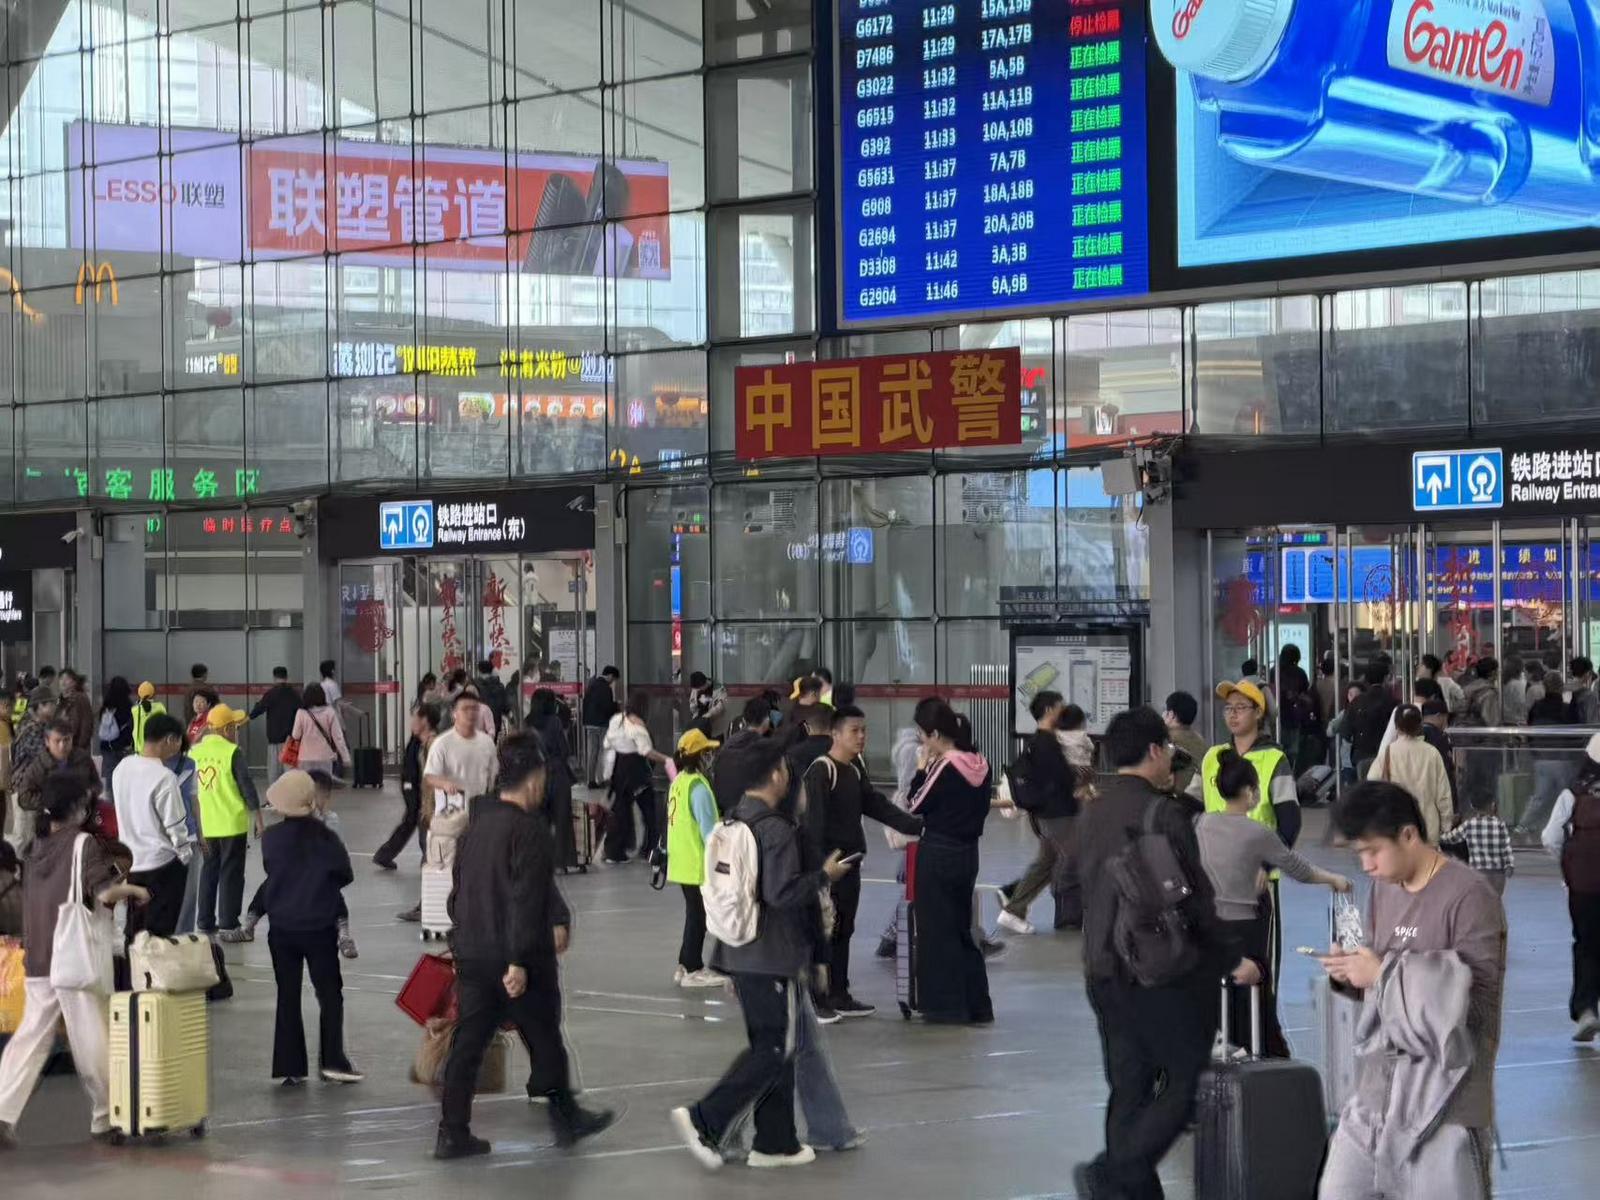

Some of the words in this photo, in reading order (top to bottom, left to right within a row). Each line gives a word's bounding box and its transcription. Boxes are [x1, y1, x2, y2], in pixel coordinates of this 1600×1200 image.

[856, 15, 892, 37] G6172
[924, 5, 954, 27] 11:29
[924, 36, 954, 59] 11:29
[857, 76, 893, 97] G3022
[924, 67, 955, 88] 11:32
[1070, 40, 1119, 68] 正在检票
[925, 98, 955, 118] 11:32
[1070, 73, 1120, 99] 正在检票
[925, 128, 955, 149] 11:33
[1071, 106, 1120, 131] 正在检票
[925, 159, 956, 179] 11:37
[1071, 138, 1121, 162] 正在检票
[181, 182, 225, 208] 联塑
[268, 167, 506, 248] 联塑管道
[862, 197, 891, 216] G908
[925, 189, 956, 209] 11:37
[1071, 170, 1121, 194] 正在检票
[859, 227, 895, 246] G2694
[926, 220, 956, 239] 11:37
[1071, 203, 1122, 226] 正在检票
[860, 257, 895, 276] D3308
[926, 250, 957, 270] 11:42
[1072, 234, 1122, 257] 正在检票
[860, 287, 896, 306] G2904
[927, 281, 958, 300] 11:46
[1072, 266, 1122, 288] 正在检票
[745, 354, 1006, 451] 中国武警
[1511, 448, 1600, 481] 铁路进站
[1511, 482, 1560, 504] Railway
[437, 503, 497, 527] 铁路进站口
[437, 528, 466, 544] Railway
[468, 526, 501, 542] Entrance
